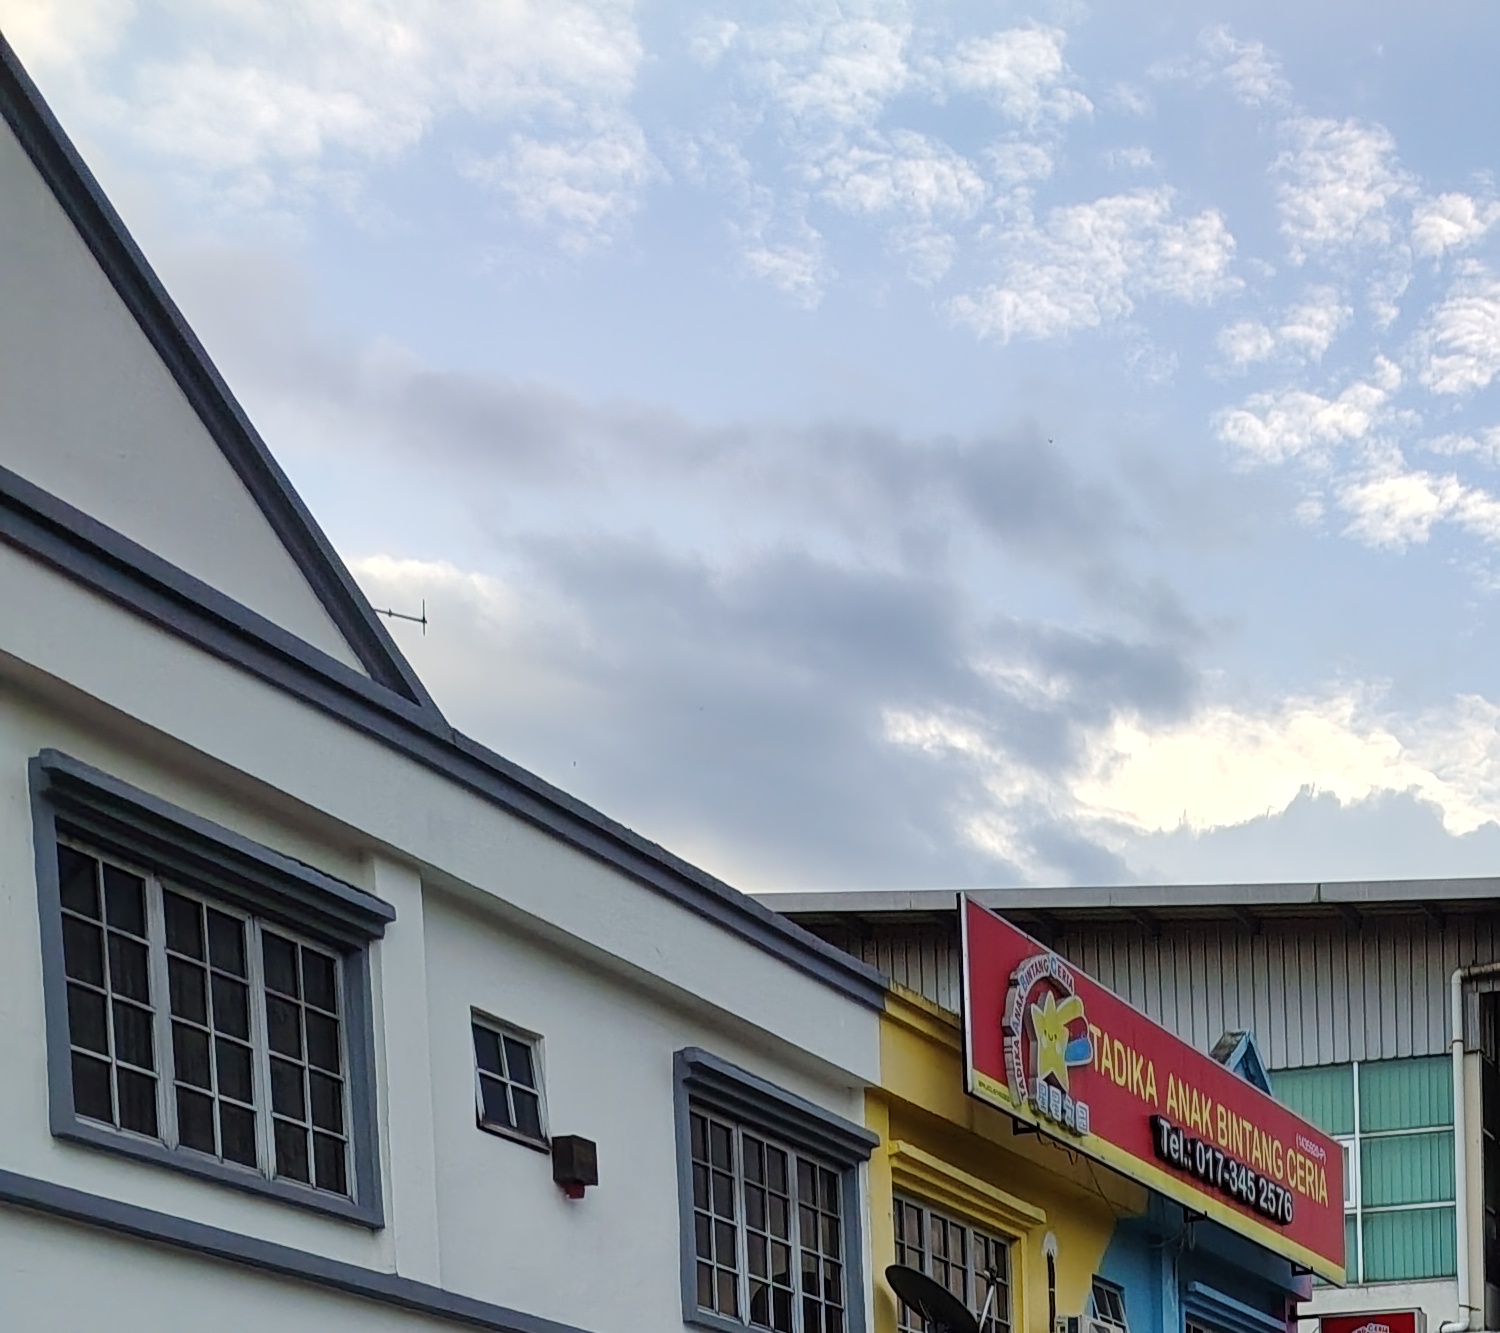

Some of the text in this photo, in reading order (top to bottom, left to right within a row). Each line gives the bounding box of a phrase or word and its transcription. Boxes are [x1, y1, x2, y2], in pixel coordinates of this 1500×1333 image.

[1019, 956, 1049, 990] BINTANG
[1089, 1022, 1329, 1208] TADIKA ANAK BINTANG CERIA
[1159, 1118, 1293, 1223] Tel.: 017-345 2576
